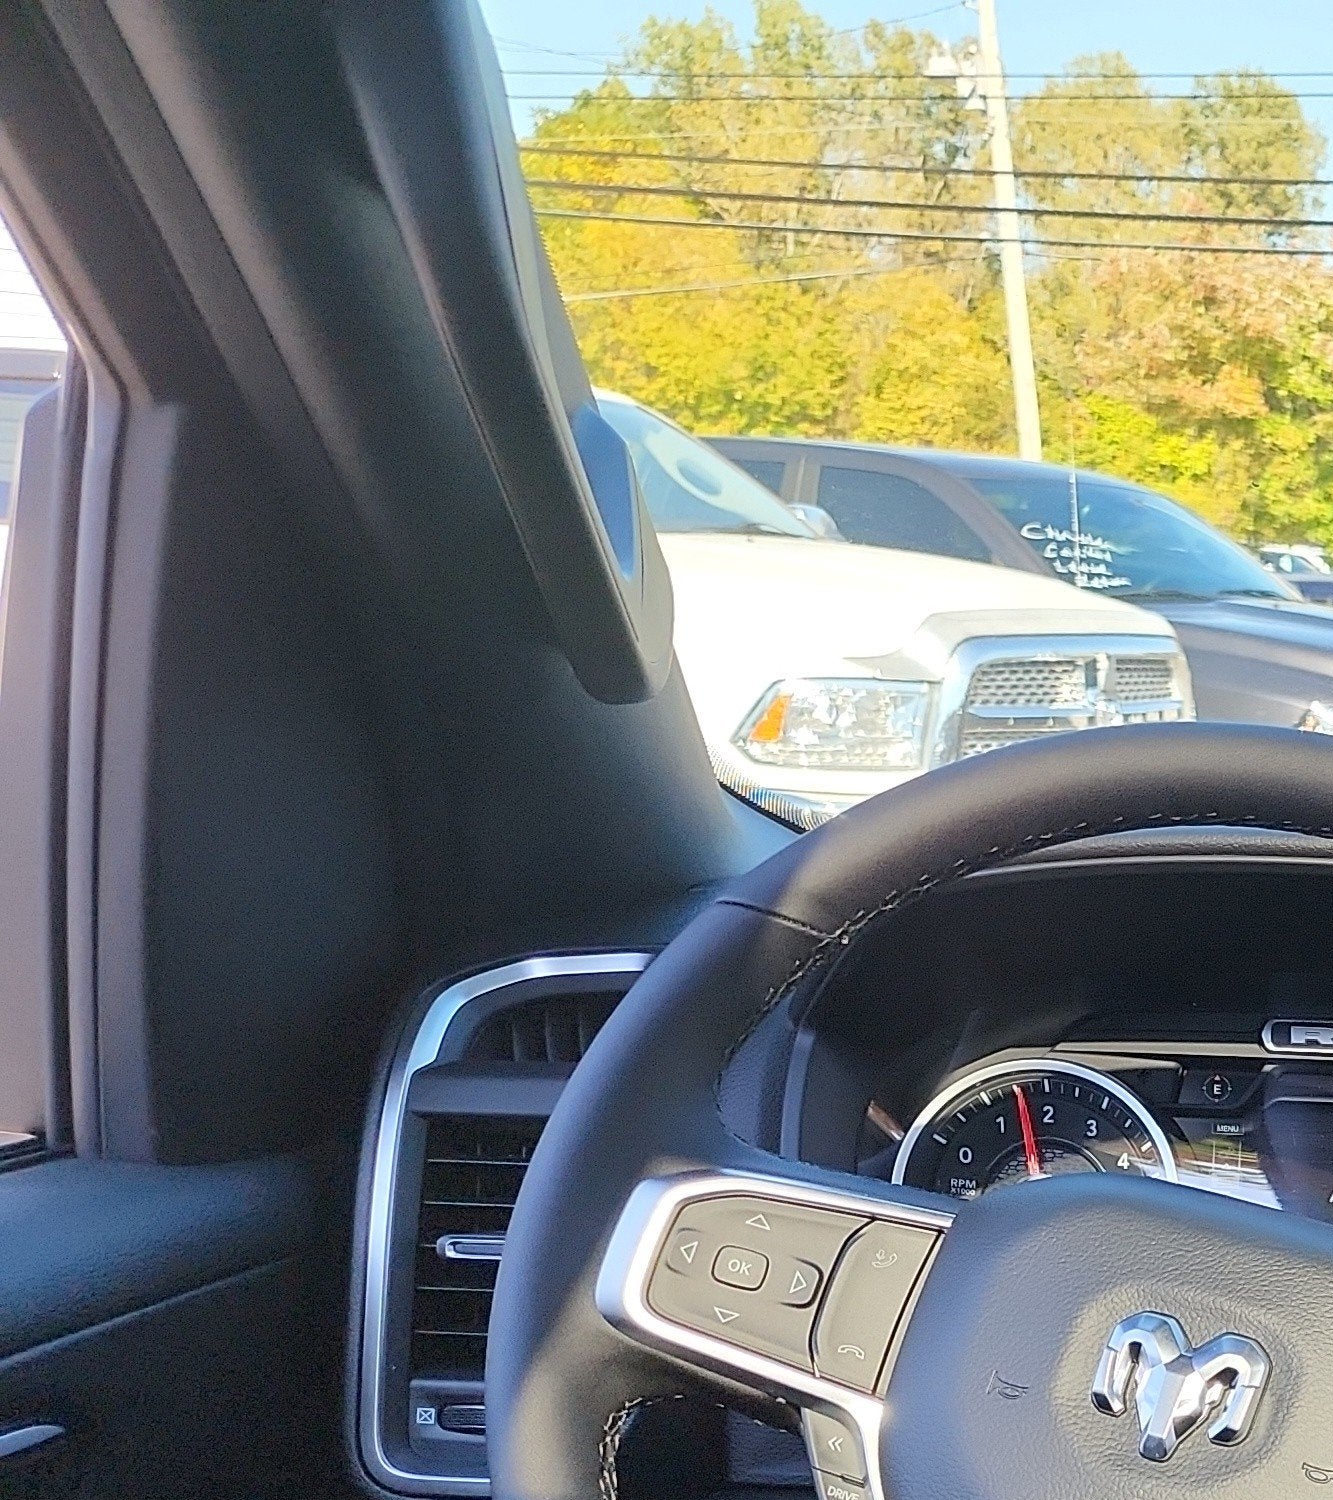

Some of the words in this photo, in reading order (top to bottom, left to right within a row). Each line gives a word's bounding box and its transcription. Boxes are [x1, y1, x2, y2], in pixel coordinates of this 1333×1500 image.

[1214, 1084, 1222, 1096] E
[1043, 1104, 1055, 1124] 2
[996, 1116, 1006, 1134] 1
[1086, 1119, 1098, 1137] 3
[1216, 1124, 1240, 1133] MENU
[959, 1147, 973, 1165] 0
[1116, 1152, 1131, 1170] 4
[950, 1178, 977, 1189] RPM
[727, 1259, 752, 1277] OK
